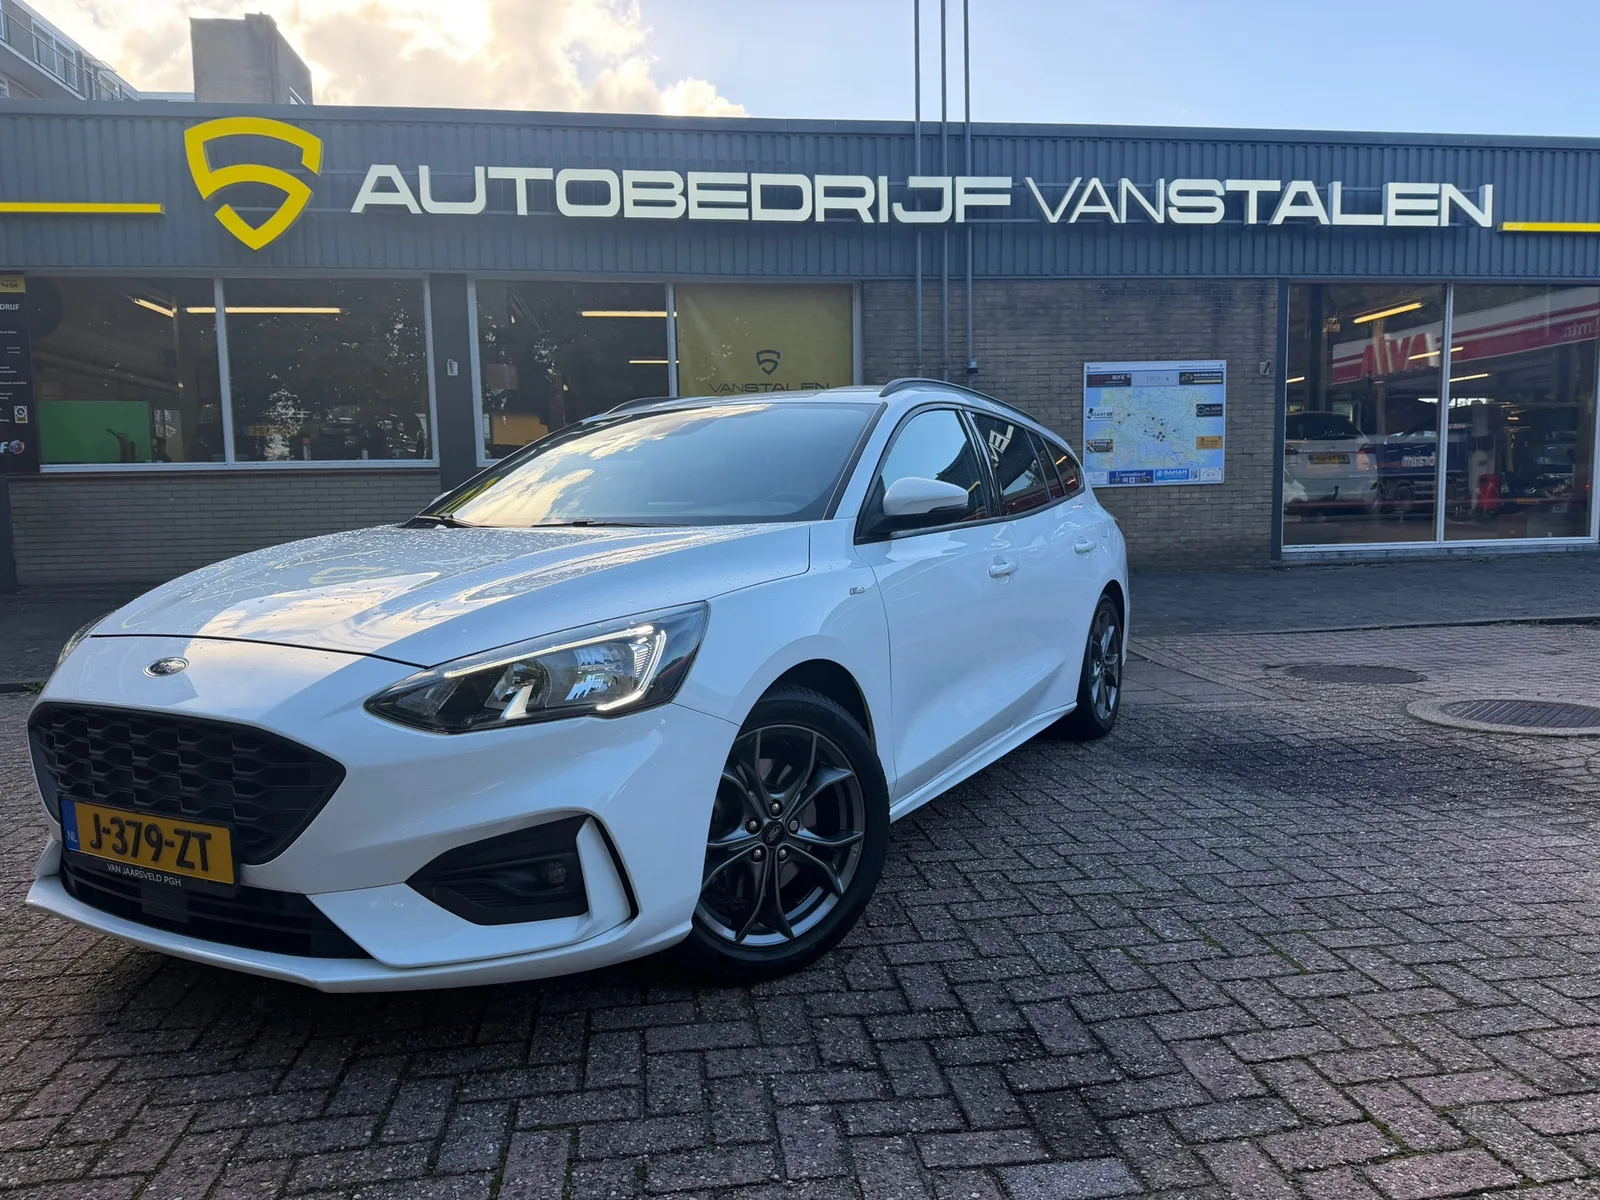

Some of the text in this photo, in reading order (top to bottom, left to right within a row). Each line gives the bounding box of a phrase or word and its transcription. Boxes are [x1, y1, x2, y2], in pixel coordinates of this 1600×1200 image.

[350, 164, 1494, 228] AUTOBEDRIJF VANSTALEN
[67, 831, 78, 843] NL
[89, 813, 212, 872] J-379-ZT
[106, 863, 182, 887] VAN JAARSVELD PGH
